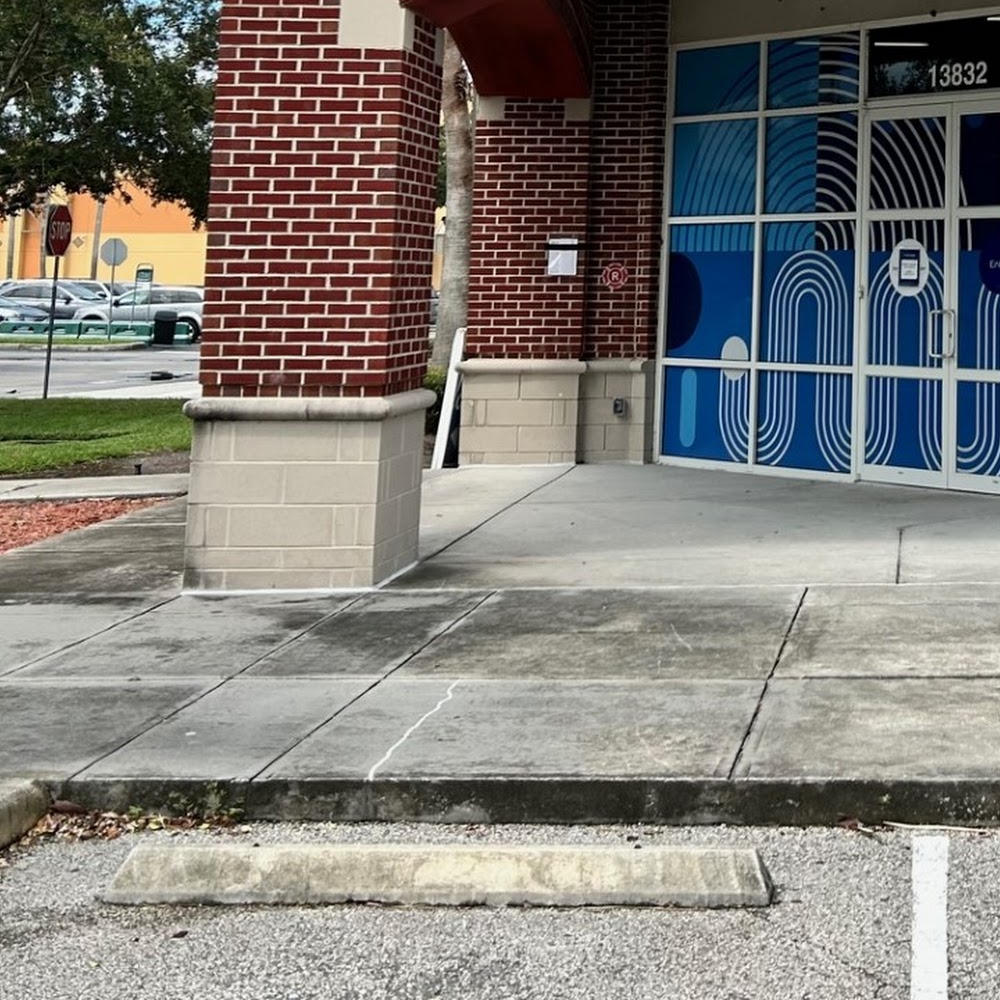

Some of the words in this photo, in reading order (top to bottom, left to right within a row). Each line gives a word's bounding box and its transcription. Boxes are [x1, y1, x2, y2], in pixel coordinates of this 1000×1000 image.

[928, 61, 988, 87] 13832
[51, 220, 71, 240] STOP
[611, 271, 619, 281] R
